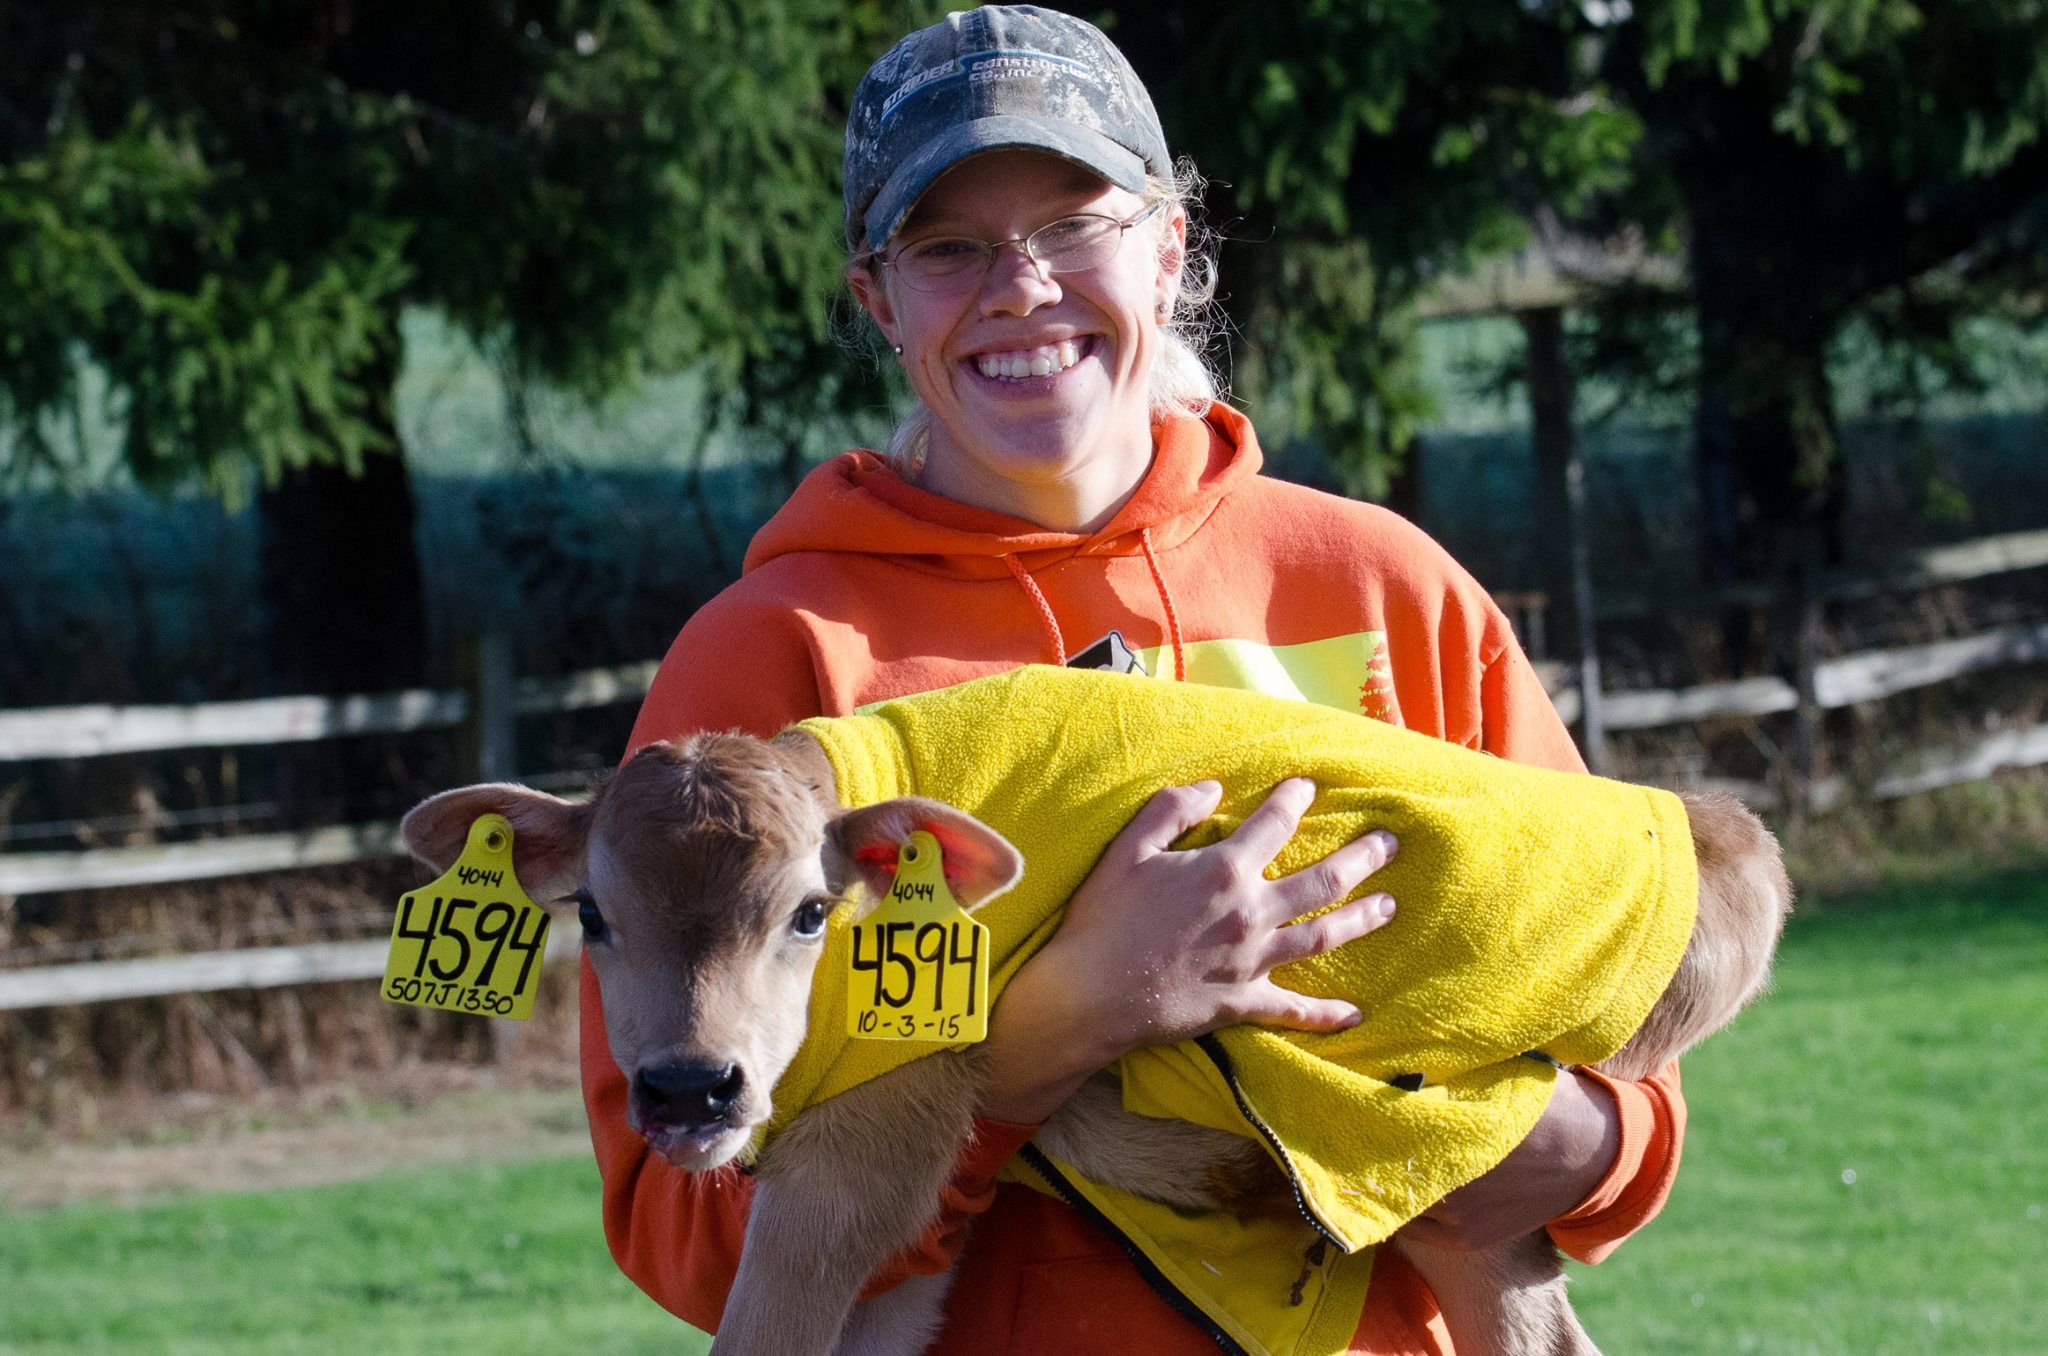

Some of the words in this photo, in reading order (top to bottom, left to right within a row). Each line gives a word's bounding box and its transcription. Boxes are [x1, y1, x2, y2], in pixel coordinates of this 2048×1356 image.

[458, 865, 505, 888] 4044
[892, 874, 935, 903] 4044
[398, 897, 551, 996] 4594
[852, 921, 981, 1016] 4594
